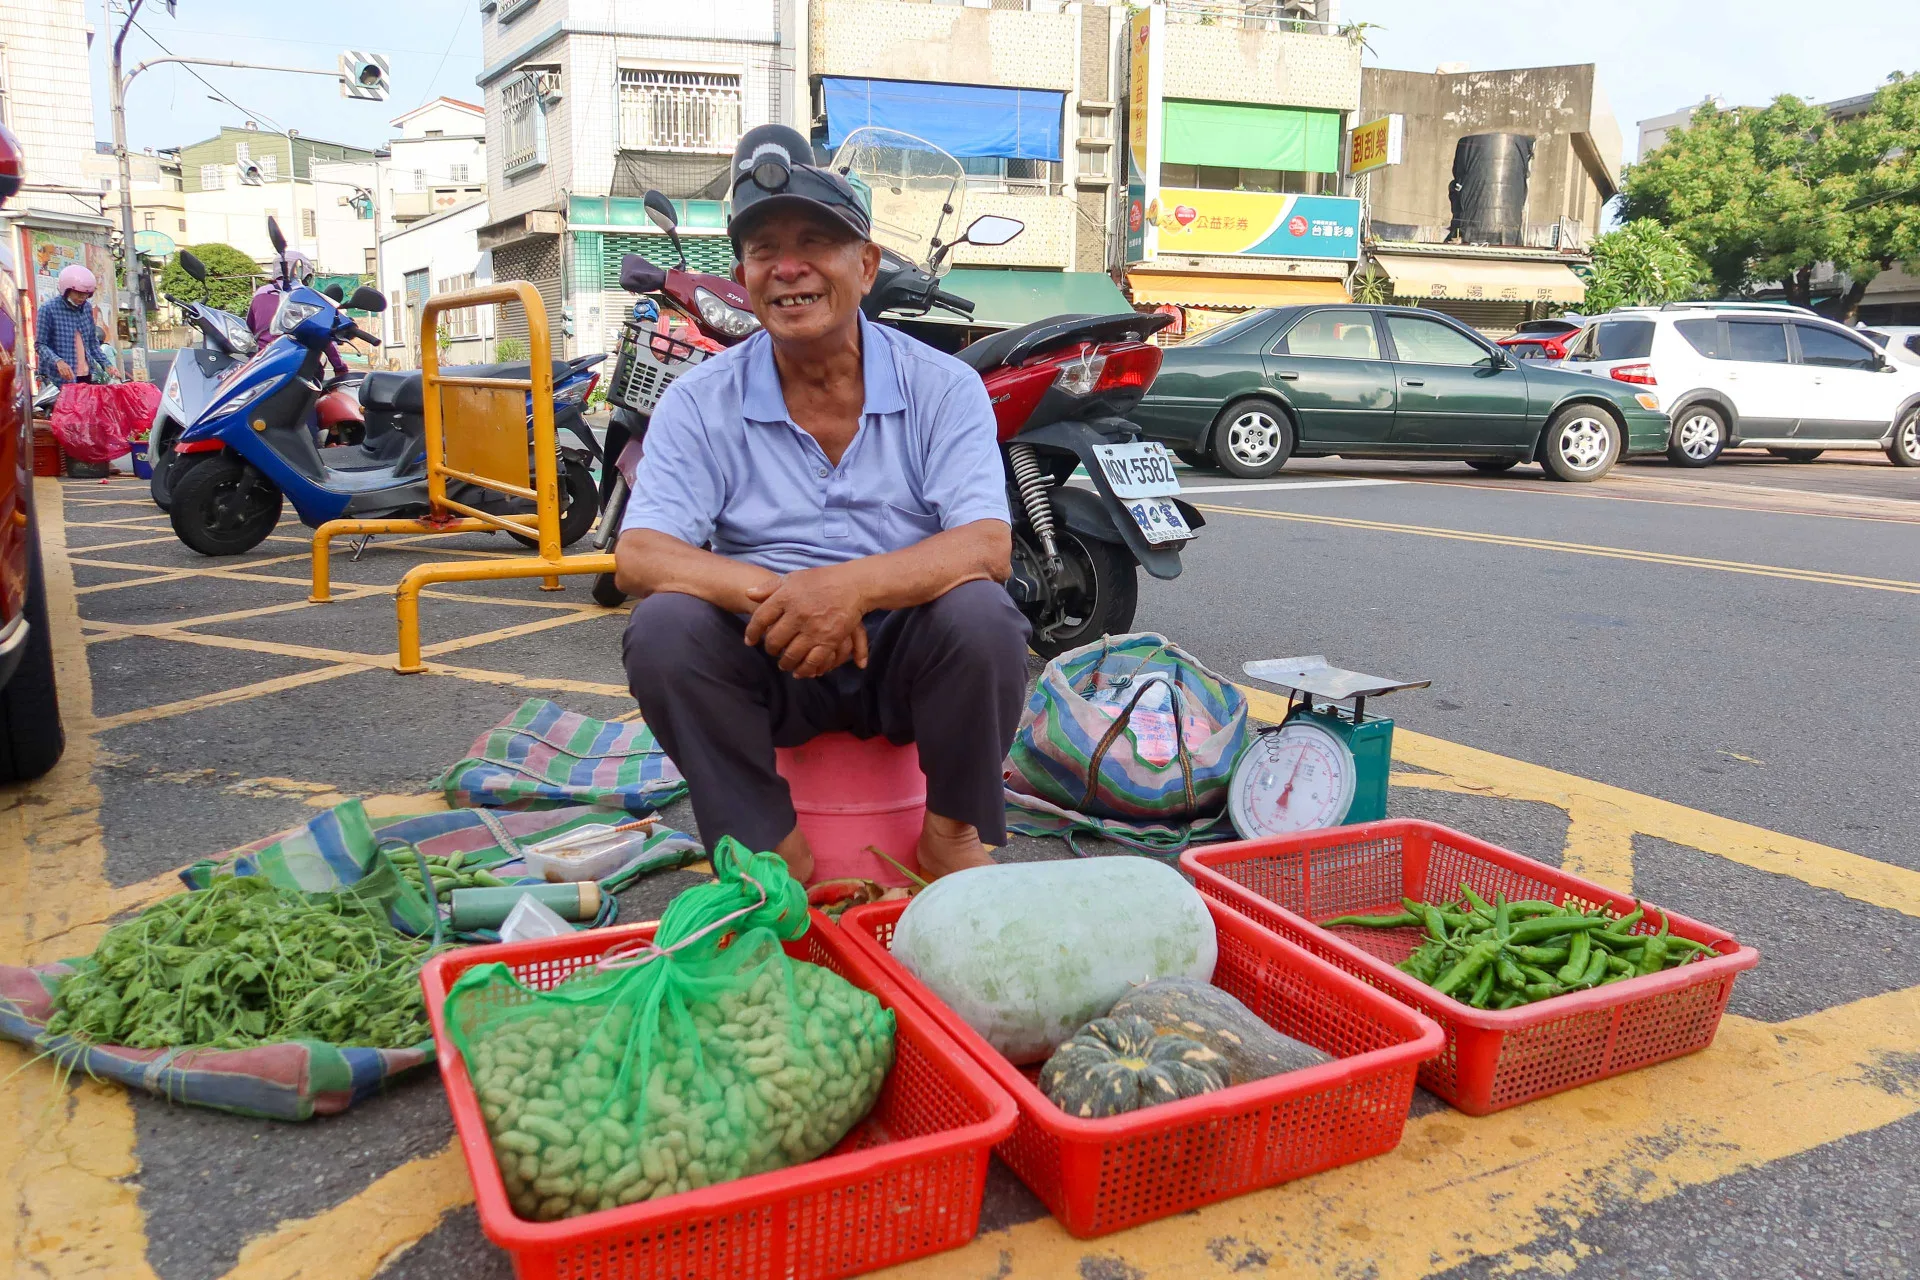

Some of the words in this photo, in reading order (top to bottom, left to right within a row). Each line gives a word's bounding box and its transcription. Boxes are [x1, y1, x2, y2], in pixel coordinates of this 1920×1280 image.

[1353, 125, 1387, 163] 刮刮樂
[1196, 214, 1248, 230] 公益彩券
[726, 292, 744, 304] SYM
